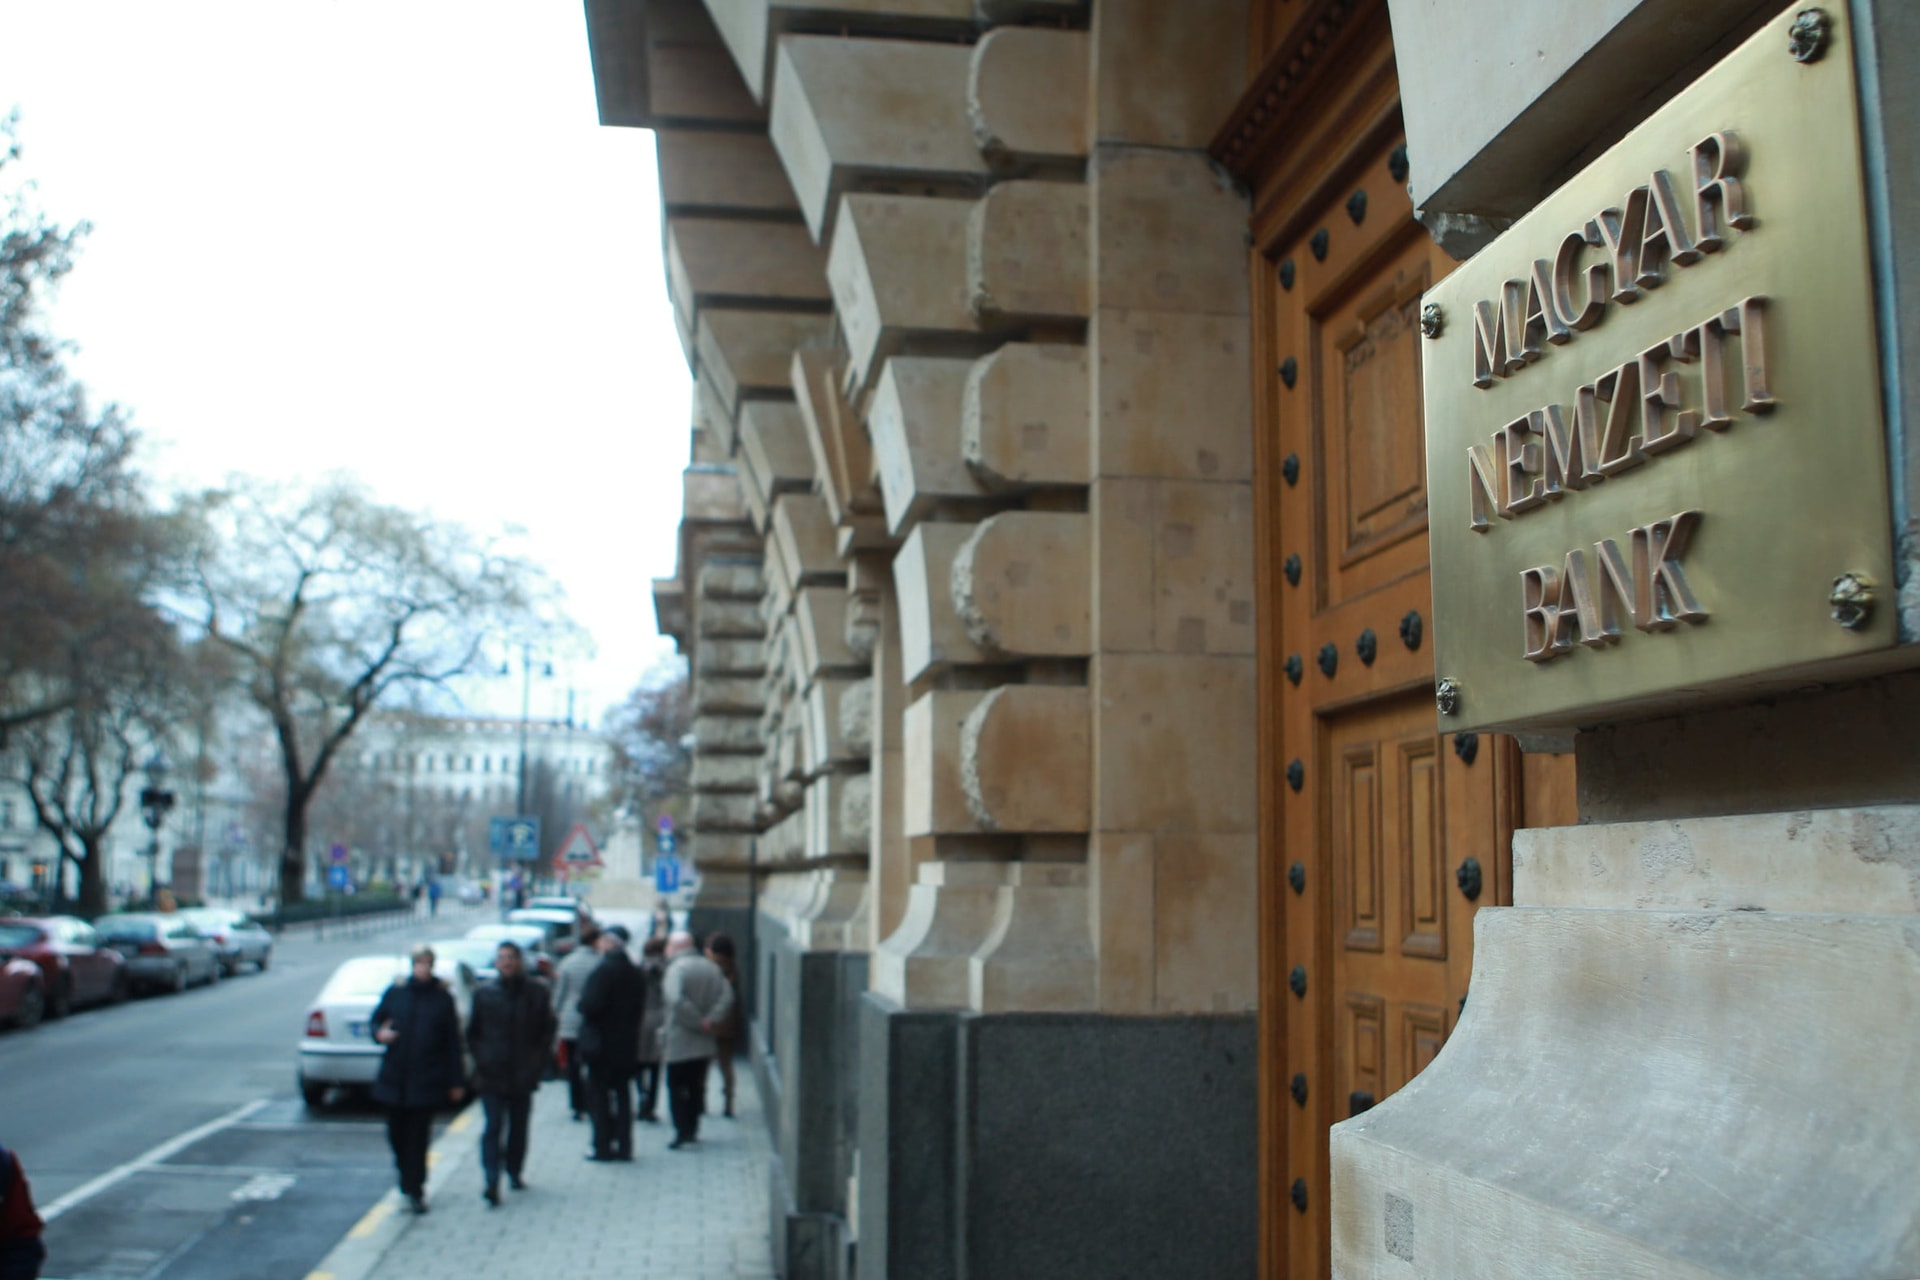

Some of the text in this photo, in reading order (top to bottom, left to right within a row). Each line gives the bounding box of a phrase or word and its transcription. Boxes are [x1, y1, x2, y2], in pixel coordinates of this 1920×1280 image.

[1472, 131, 1754, 388] MAGYAR
[1467, 296, 1775, 532] NEMZETI
[1519, 511, 1708, 661] BANK
